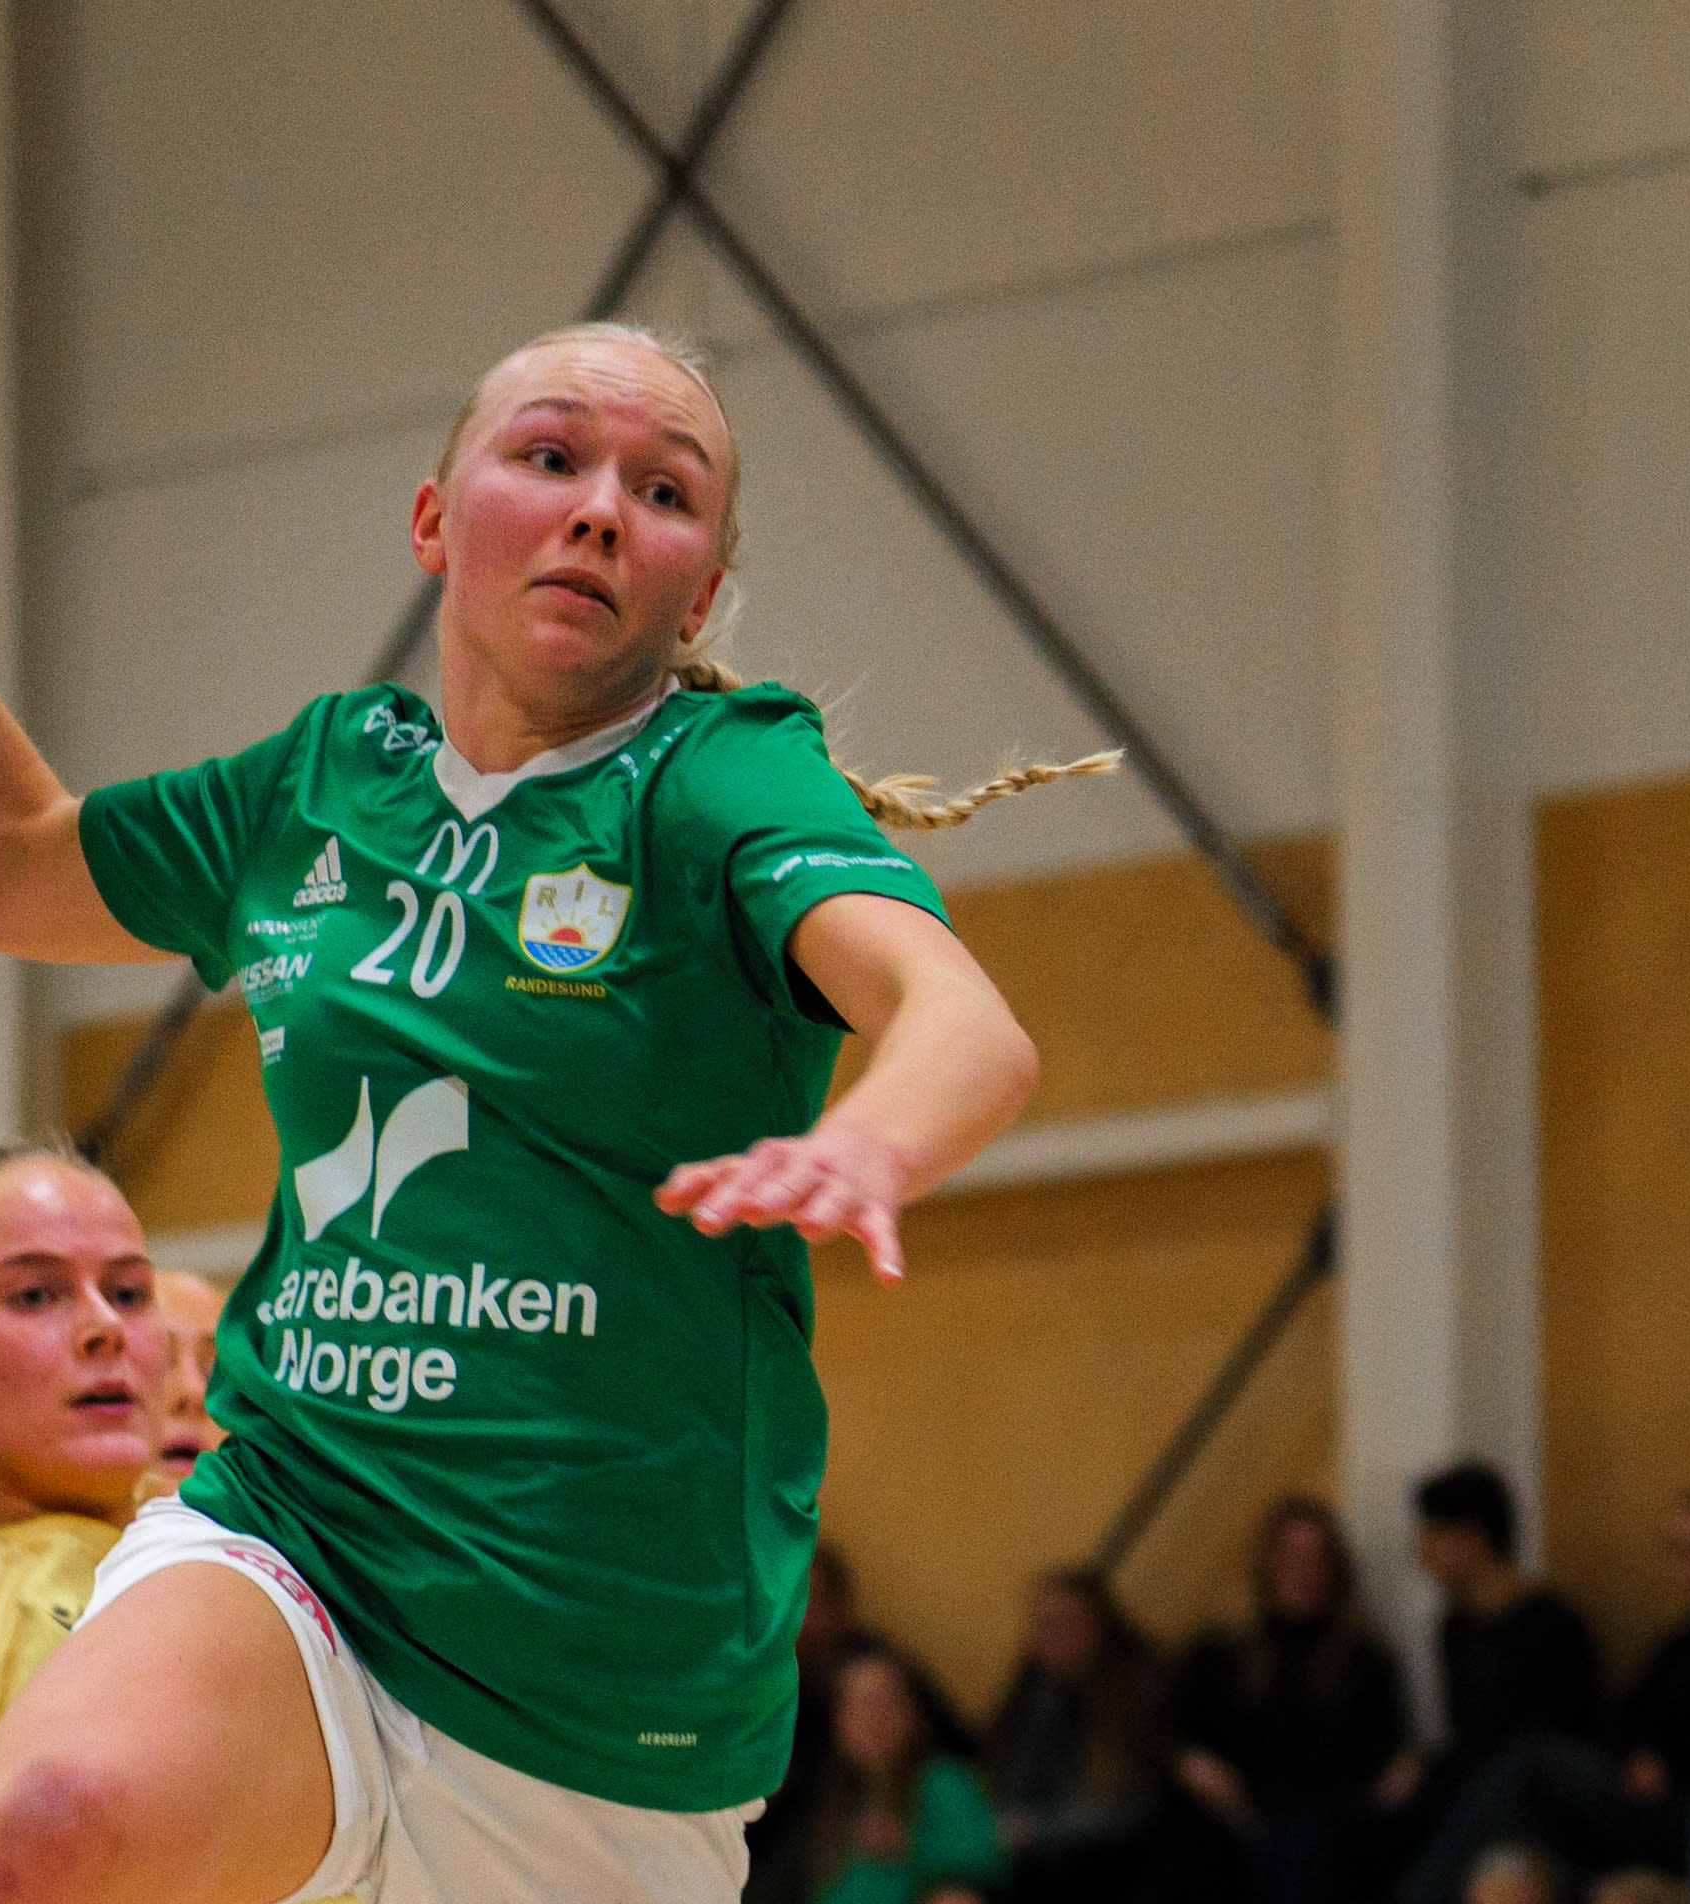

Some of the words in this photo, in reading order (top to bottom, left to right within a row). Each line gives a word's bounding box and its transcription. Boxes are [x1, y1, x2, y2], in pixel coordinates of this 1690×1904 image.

[349, 879, 466, 1000] 20
[504, 975, 608, 999] RANDESUND
[256, 1256, 598, 1338] arebanken
[274, 1326, 458, 1414] Norge
